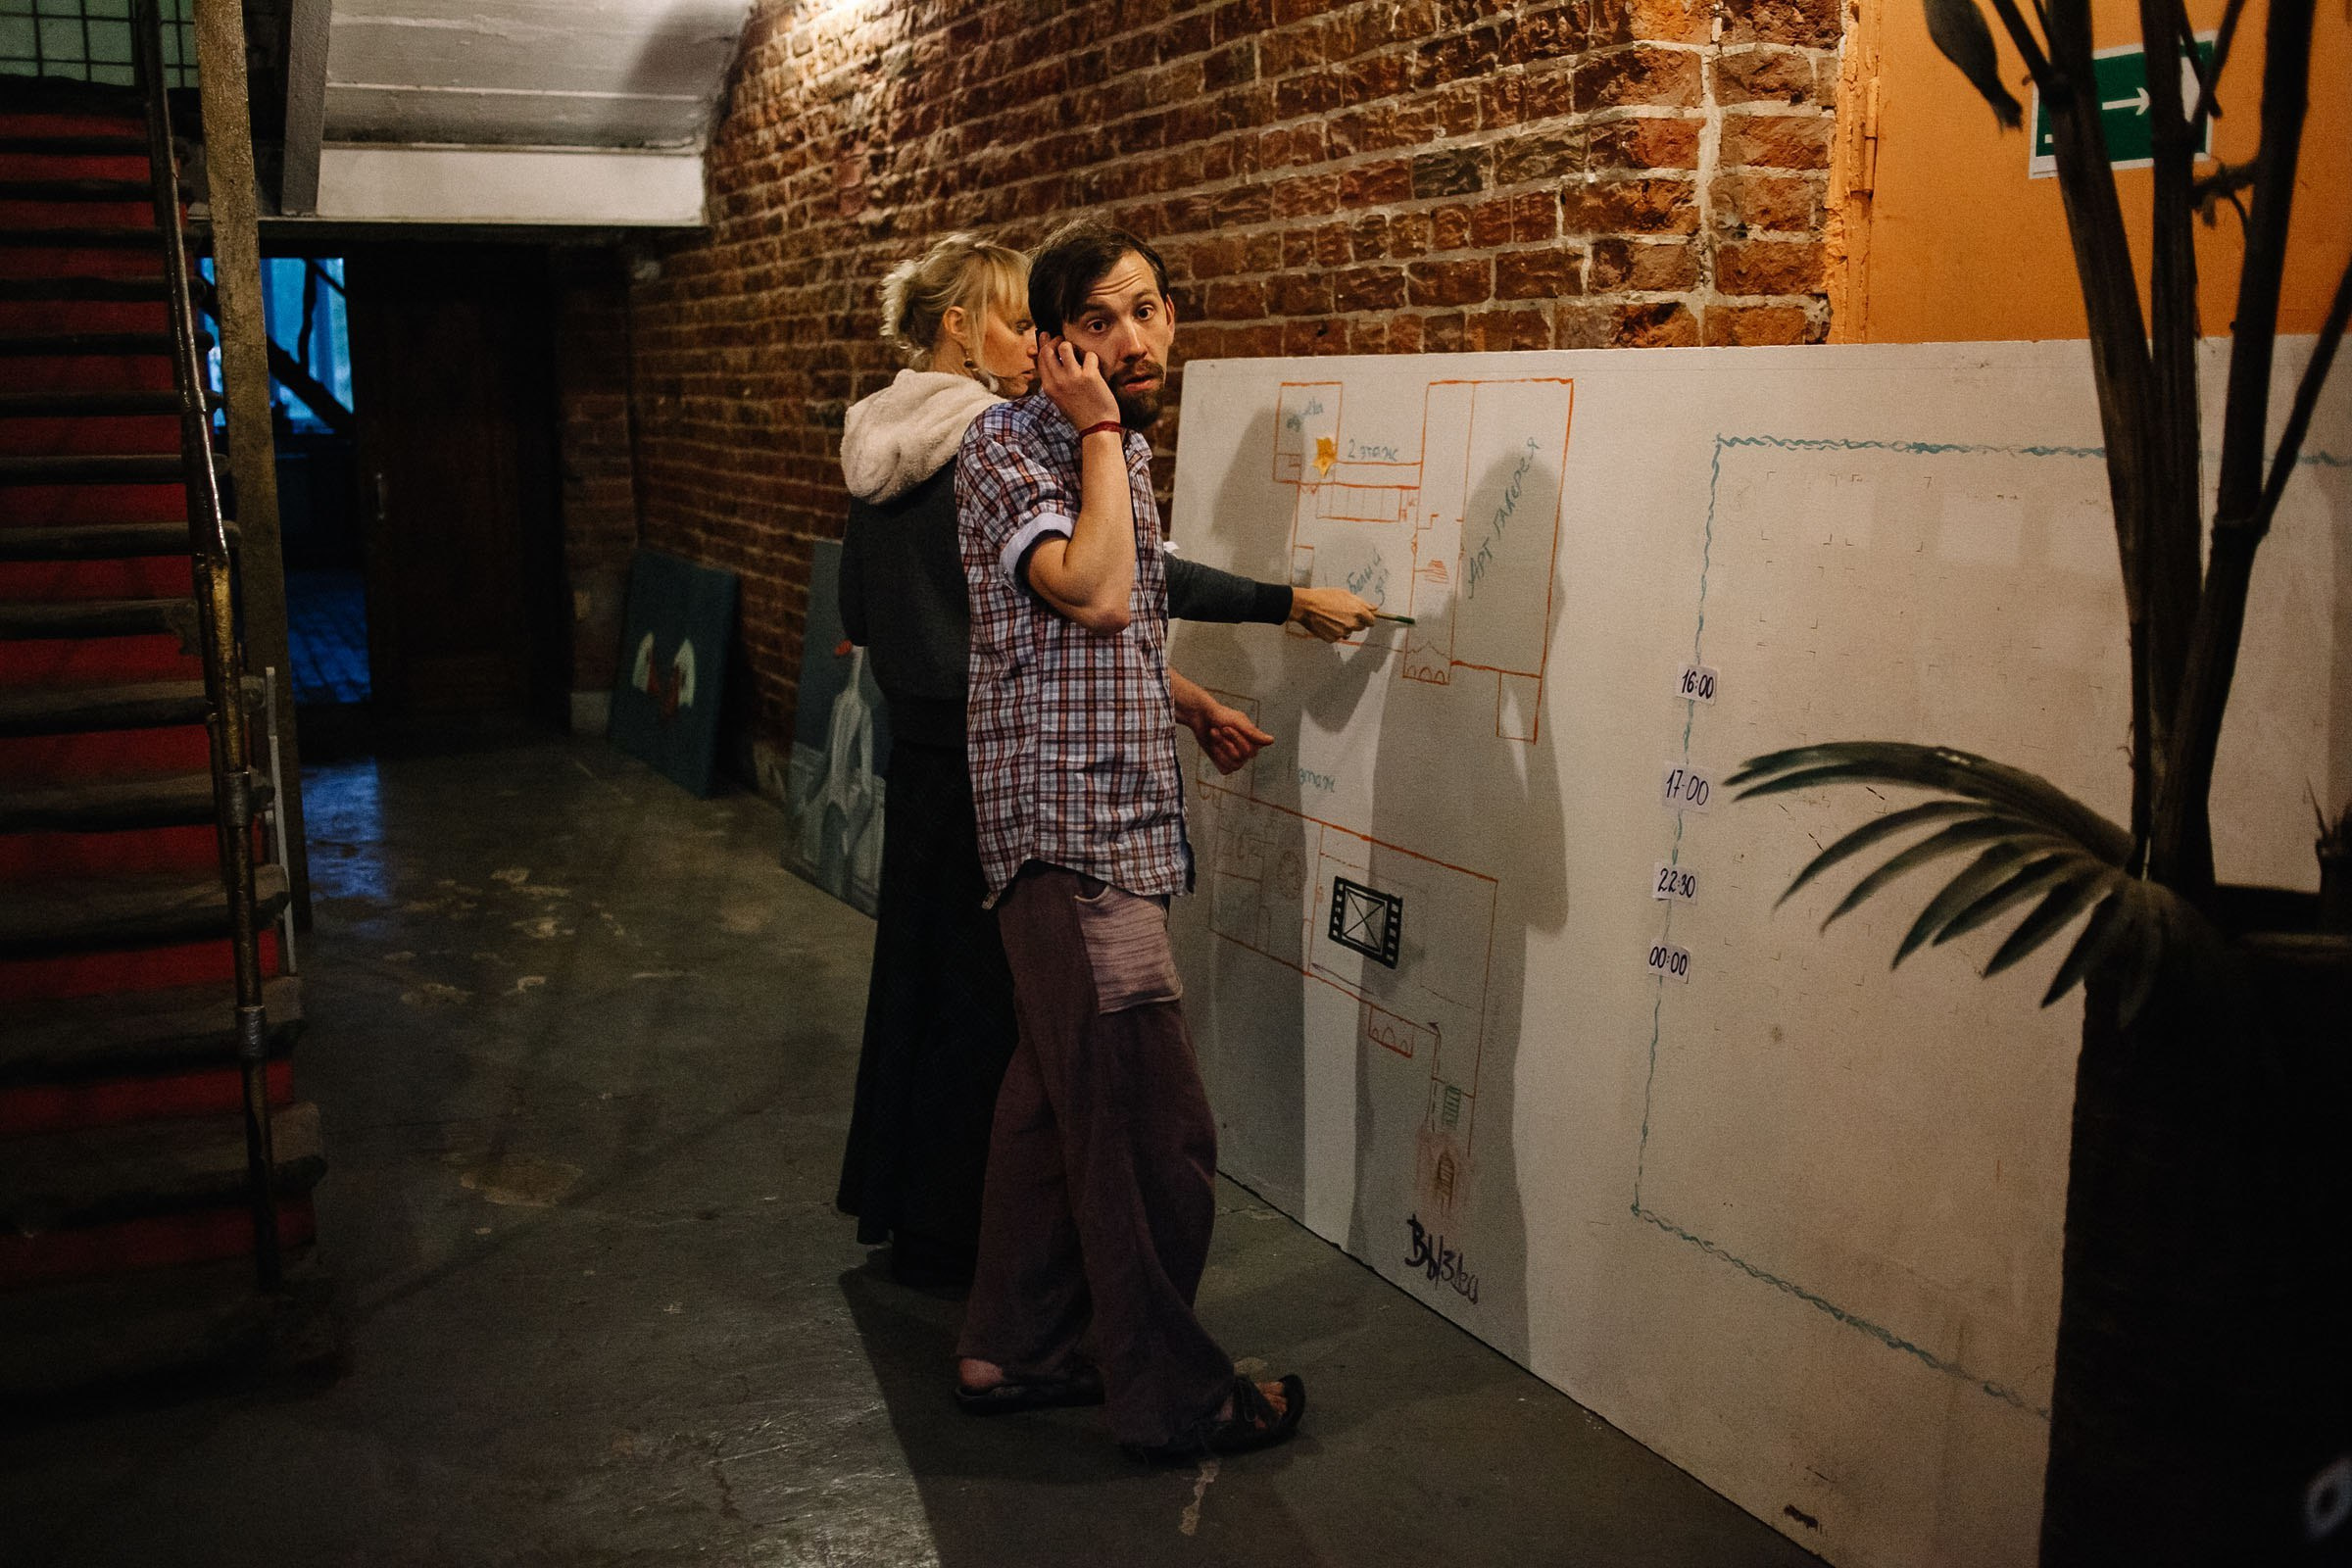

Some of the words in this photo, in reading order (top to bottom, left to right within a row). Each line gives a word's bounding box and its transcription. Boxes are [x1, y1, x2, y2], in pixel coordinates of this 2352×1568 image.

[1348, 438, 1355, 459] 2
[1681, 668, 1715, 700] 16:00
[1657, 867, 1696, 899] 22:30
[1648, 945, 1689, 976] 00:00
